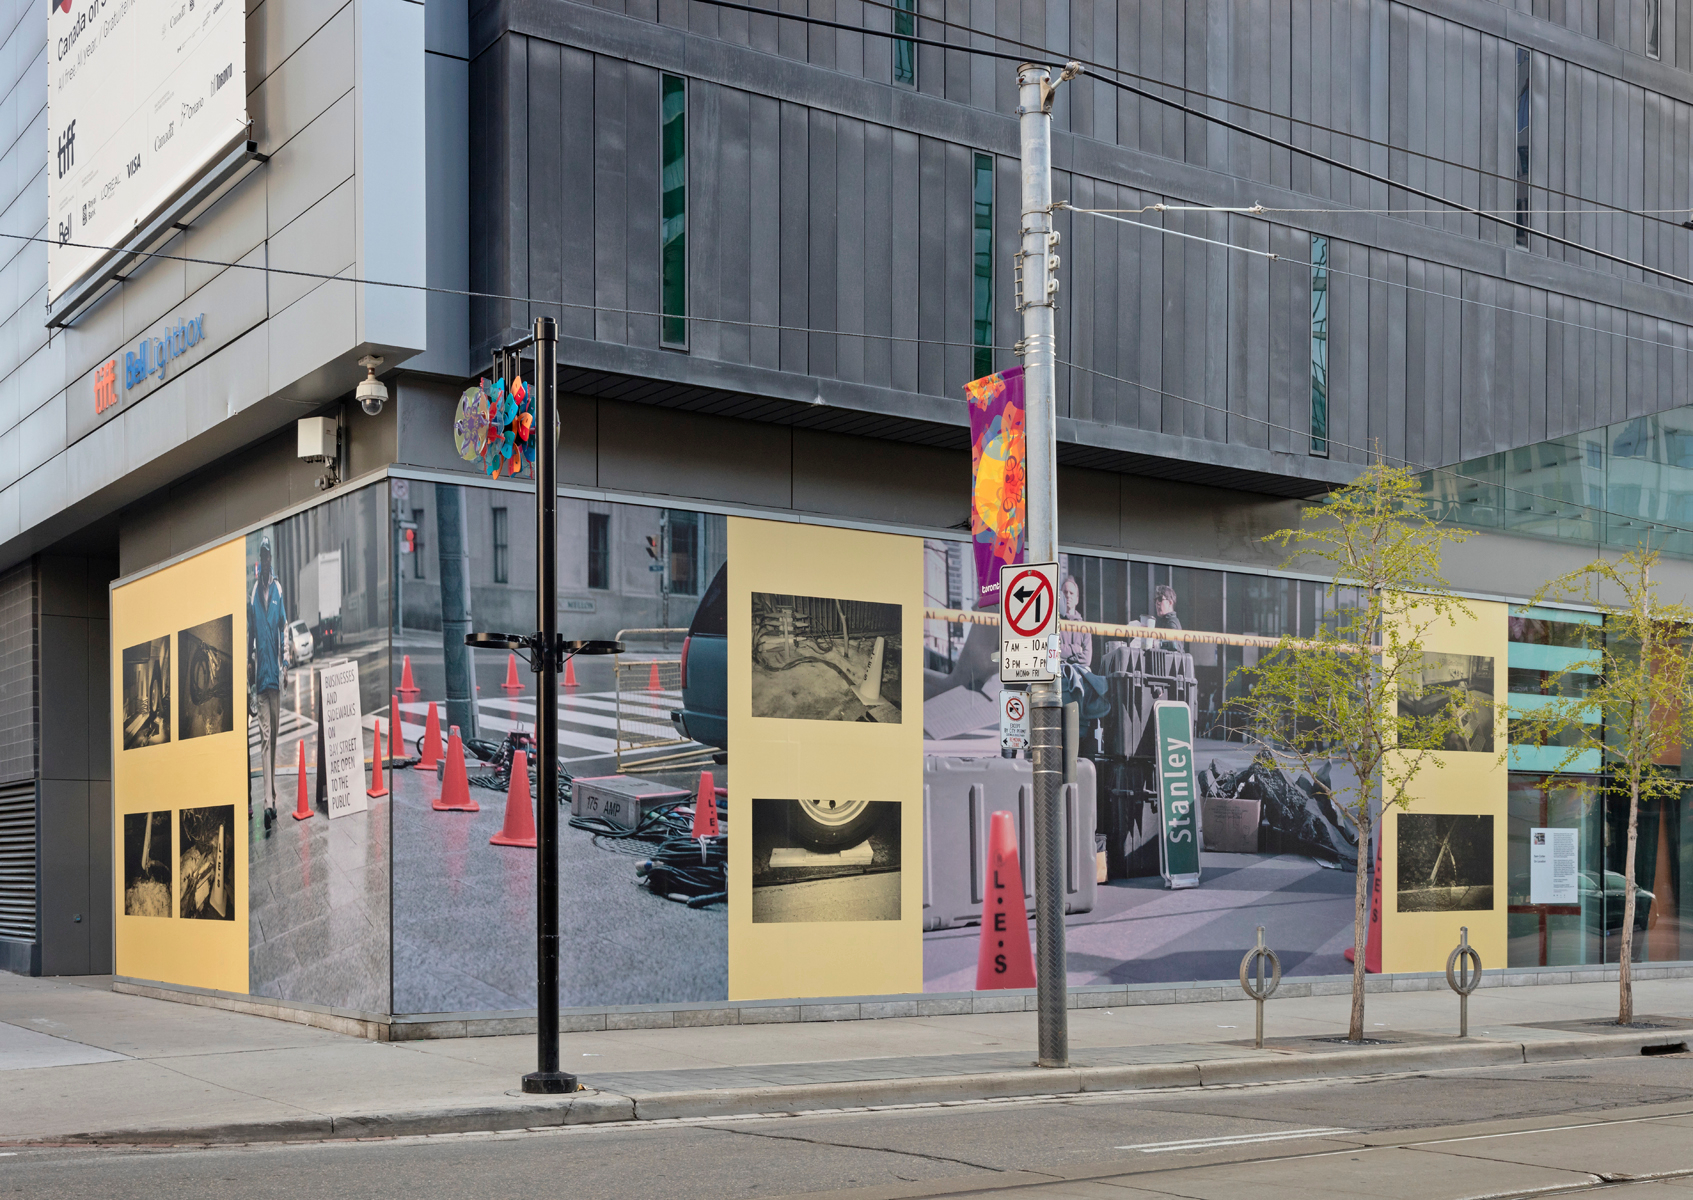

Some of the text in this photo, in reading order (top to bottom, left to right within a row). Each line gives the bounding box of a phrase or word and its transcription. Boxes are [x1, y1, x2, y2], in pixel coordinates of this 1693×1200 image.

[58, 0, 99, 61] Canada on
[57, 118, 76, 179] tiff
[126, 153, 141, 178] VISA
[59, 213, 72, 249] Bell
[982, 582, 1000, 593] toront
[958, 613, 1000, 626] CAUTI
[1004, 640, 1009, 652] 7
[1011, 643, 1020, 651] AM
[1032, 639, 1040, 651] 10
[1005, 657, 1010, 669] 3
[1012, 660, 1021, 668] PM
[1033, 656, 1038, 668] 7
[325, 669, 355, 689] BUSINESSES
[1016, 669, 1026, 677] MON
[326, 692, 338, 706] AND
[327, 703, 356, 722] SIDEWALKS
[328, 727, 336, 739] ON
[329, 738, 357, 757] BAY STREET
[330, 755, 356, 774] ARE OPEN
[331, 775, 349, 792] TO THE
[1164, 737, 1192, 843] Stanley
[332, 793, 351, 810] PUBLIC
[587, 795, 621, 818] 175 AMP
